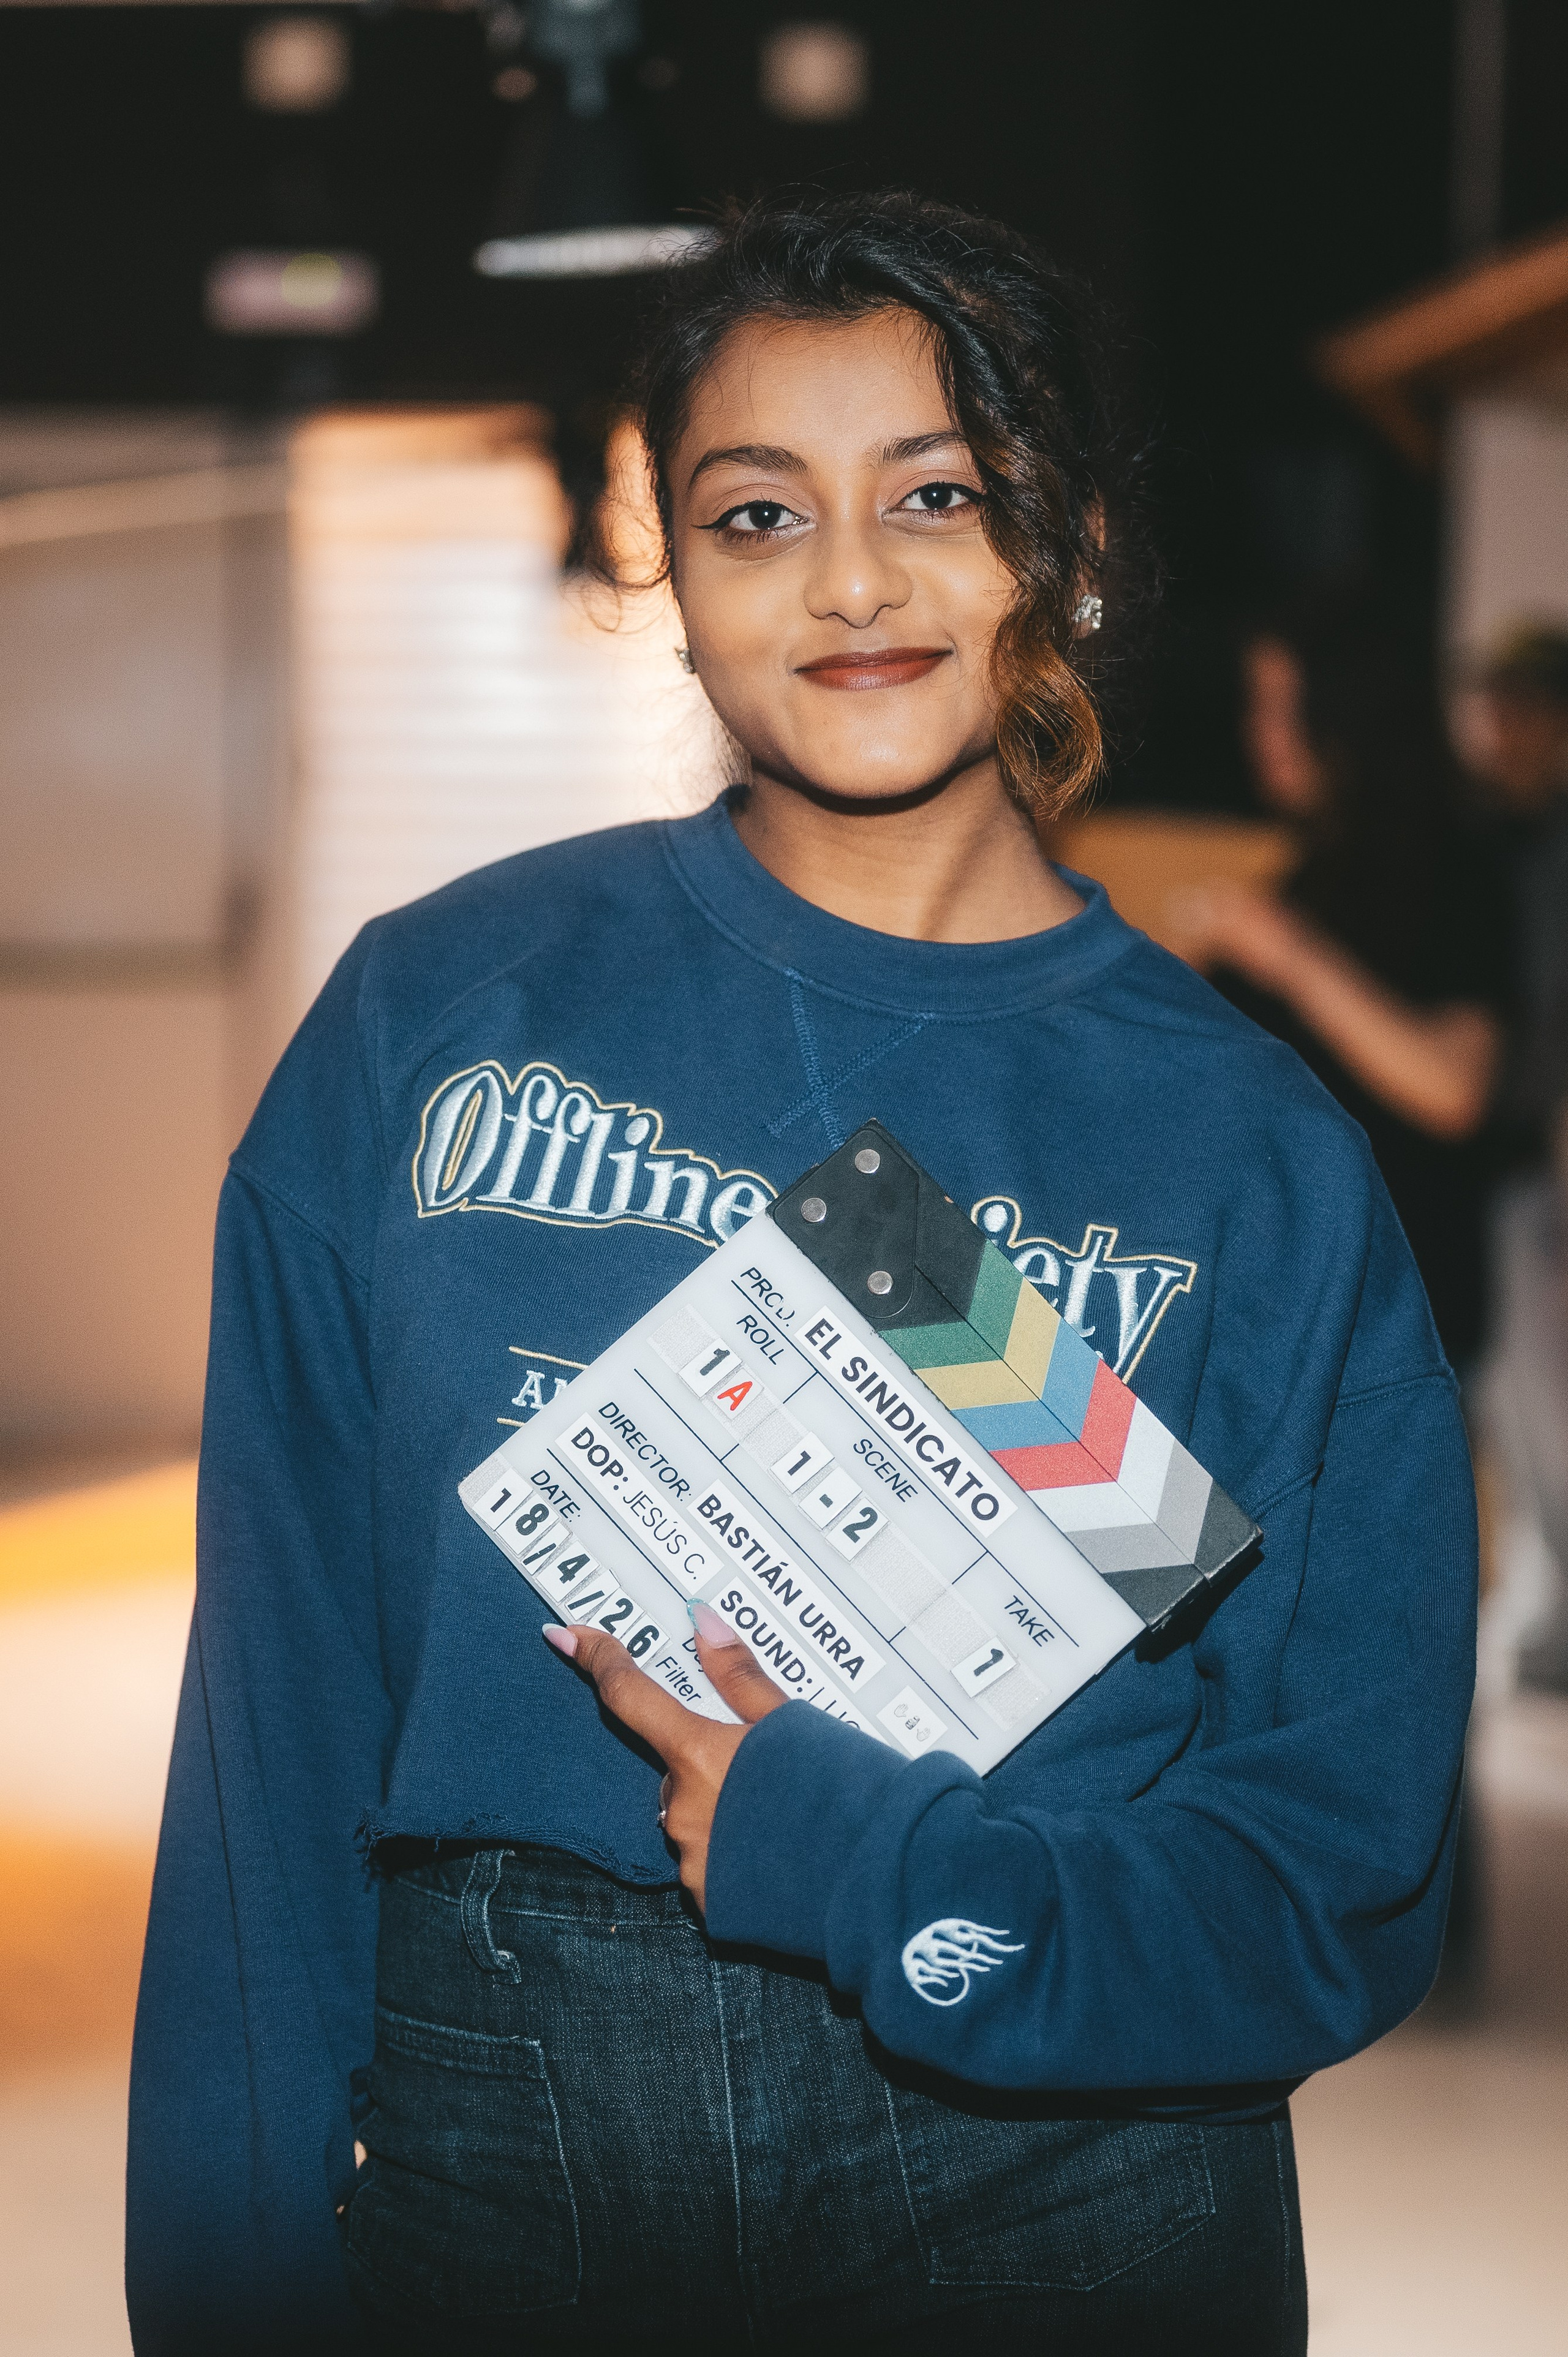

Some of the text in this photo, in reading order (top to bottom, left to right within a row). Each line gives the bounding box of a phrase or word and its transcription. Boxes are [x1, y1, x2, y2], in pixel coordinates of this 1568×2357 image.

[423, 1069, 1183, 1374] Offline ety
[736, 1314, 785, 1365] ROLL
[804, 1318, 842, 1360] EL
[841, 1357, 1001, 1521] SINDICATO
[530, 1469, 581, 1523] DATE:
[571, 1427, 628, 1490] DOP:
[622, 1490, 688, 1555] JESÚS
[684, 1553, 705, 1580] C.
[852, 1437, 919, 1504] SCENE
[598, 1401, 692, 1502] DIRECTOR:
[696, 1493, 802, 1608] BASTIÁN
[799, 1603, 865, 1681] URRA
[720, 1590, 813, 1693] SOUND:
[1003, 1594, 1055, 1648] TAKE
[655, 1656, 702, 1702] Filter
[973, 1648, 1005, 1677] 1
